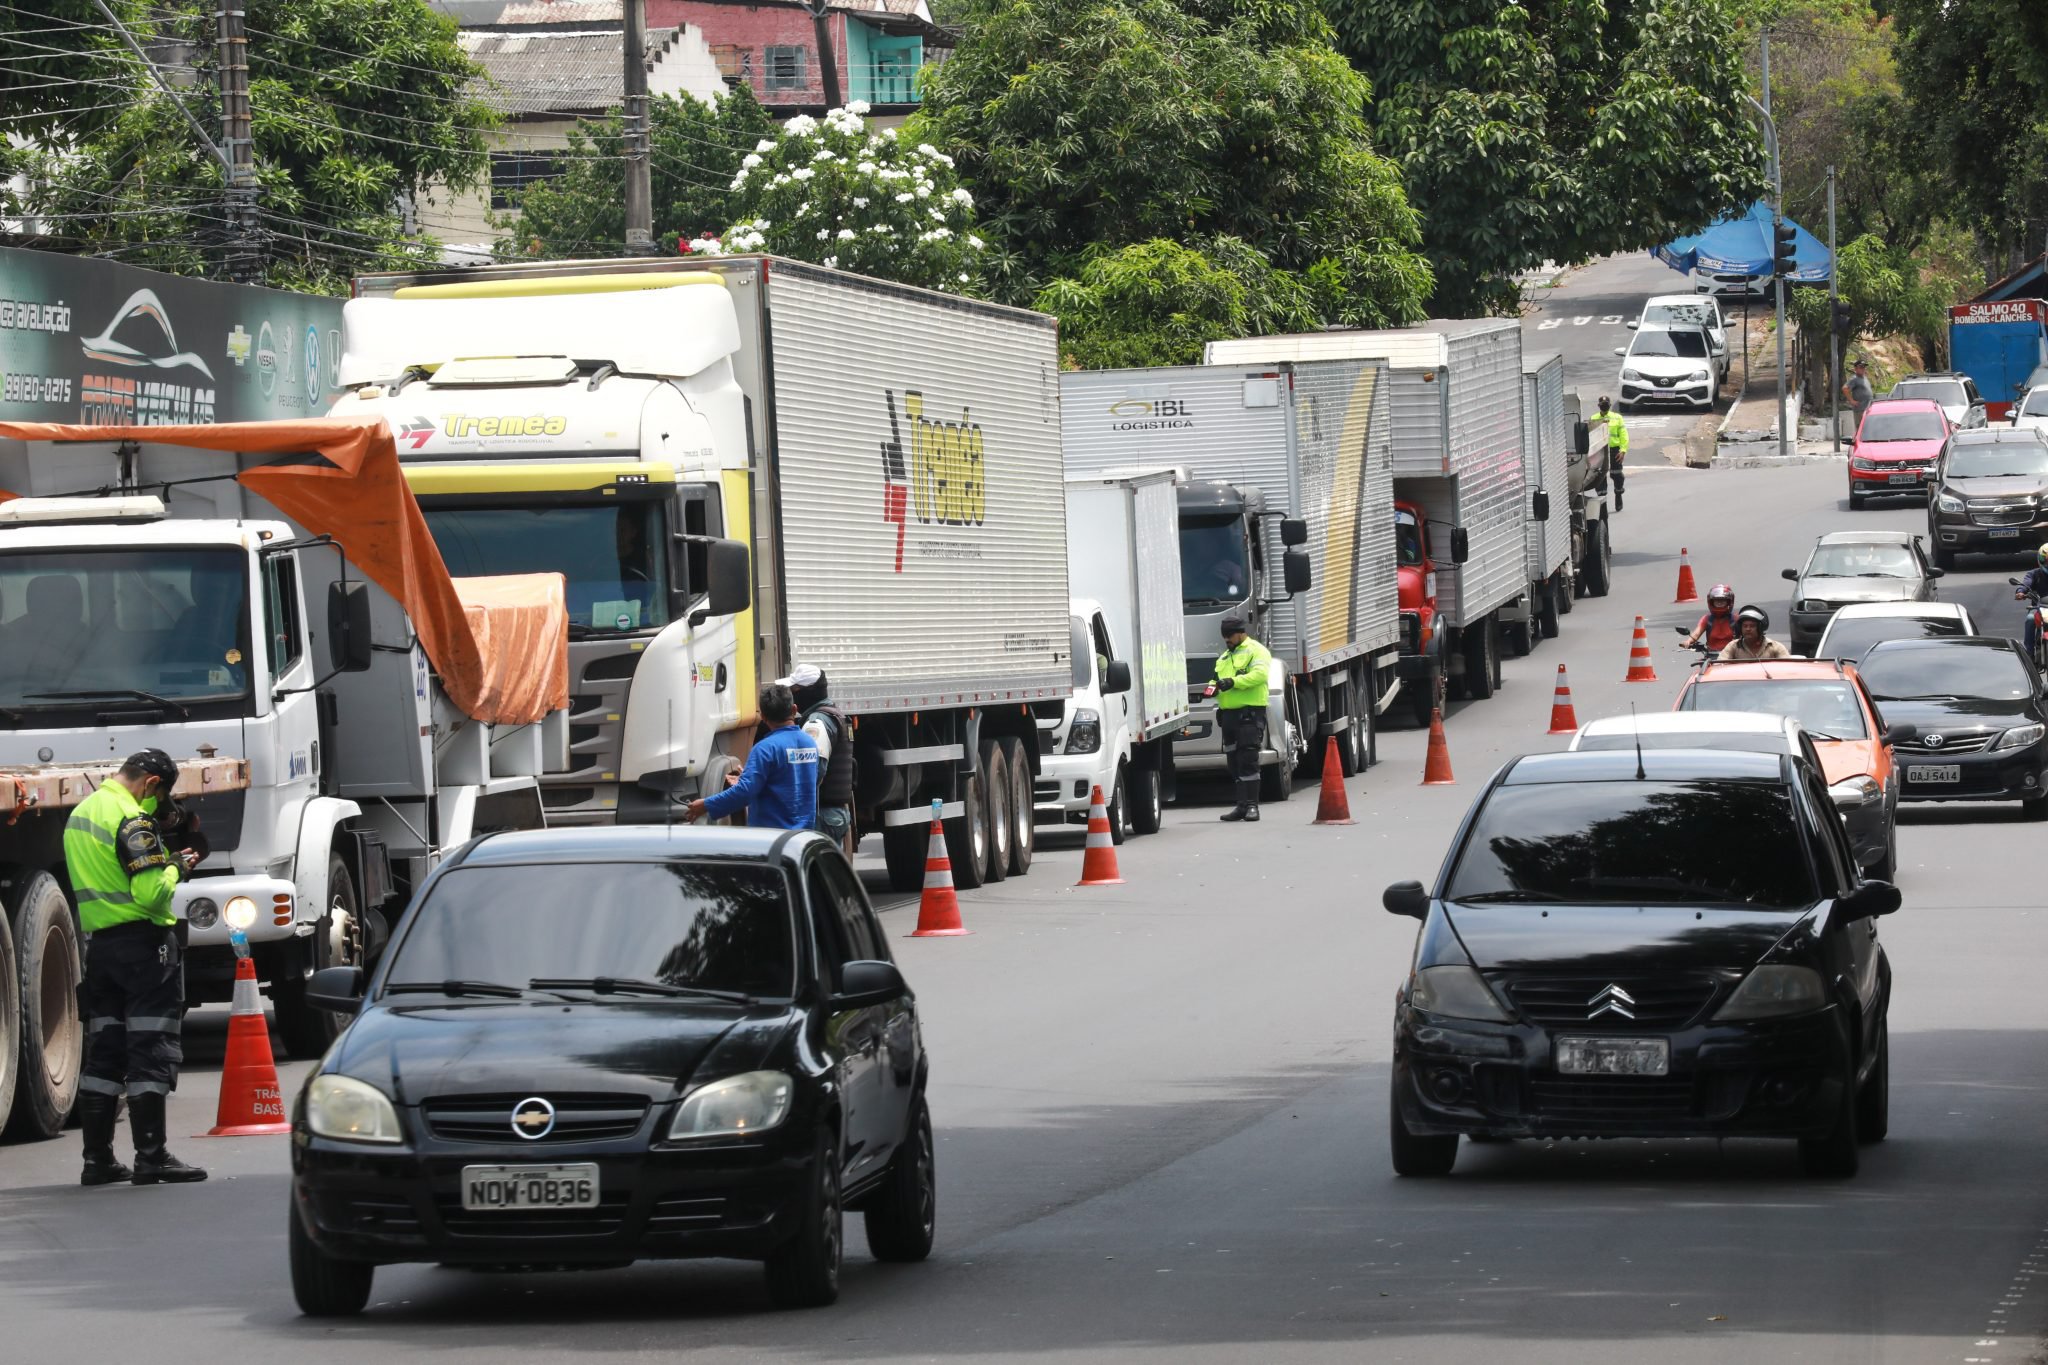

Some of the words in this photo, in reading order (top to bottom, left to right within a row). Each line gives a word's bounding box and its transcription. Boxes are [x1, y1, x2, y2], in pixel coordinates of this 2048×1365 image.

[1969, 304, 2009, 316] SALMO
[2010, 303, 2026, 314] 40
[1954, 315, 1990, 324] BOMBONS
[1995, 313, 2033, 323] LANCHES
[1154, 400, 1193, 417] IBL
[440, 412, 567, 437] Treméa
